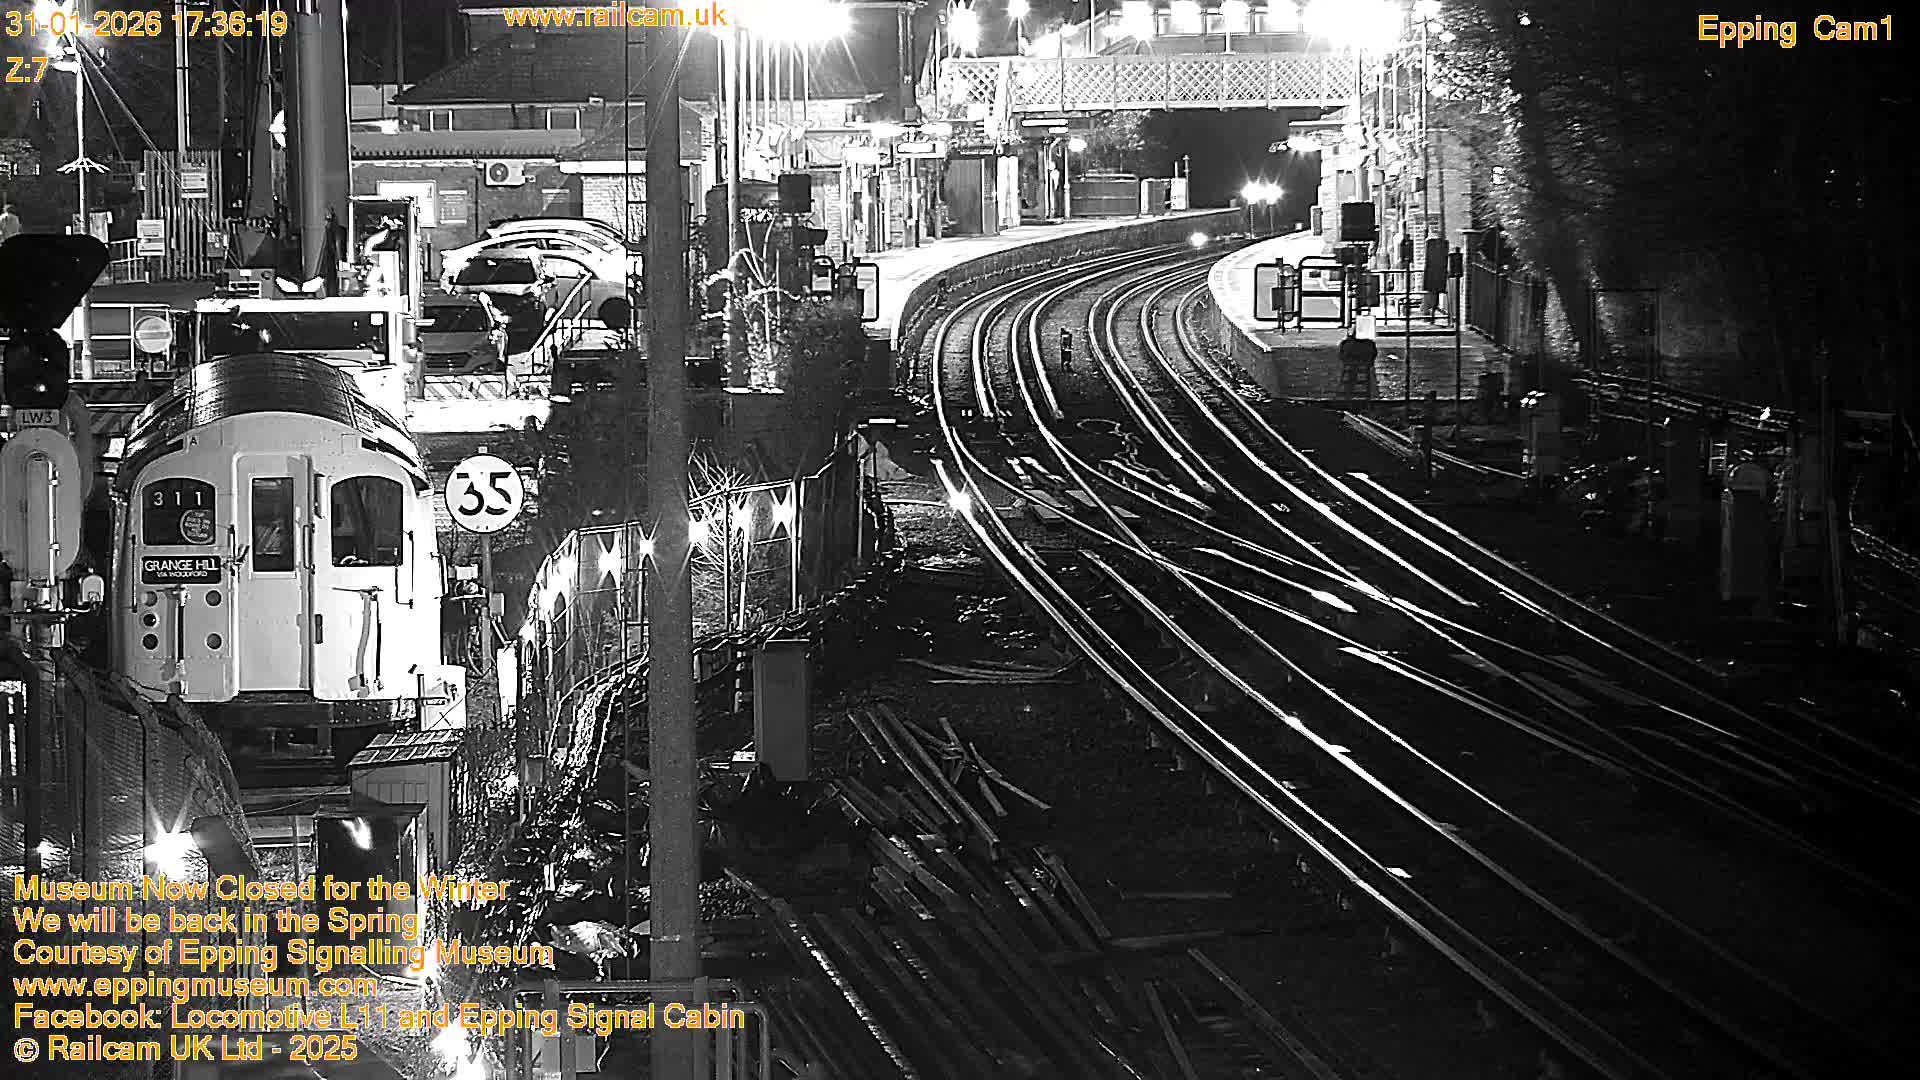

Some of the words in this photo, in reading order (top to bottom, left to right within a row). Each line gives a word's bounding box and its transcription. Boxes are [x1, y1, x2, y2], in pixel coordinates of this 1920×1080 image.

[22, 412, 53, 423] LW3
[456, 471, 512, 516] 35
[144, 559, 194, 572] GRANGE
[195, 558, 219, 571] HILL
